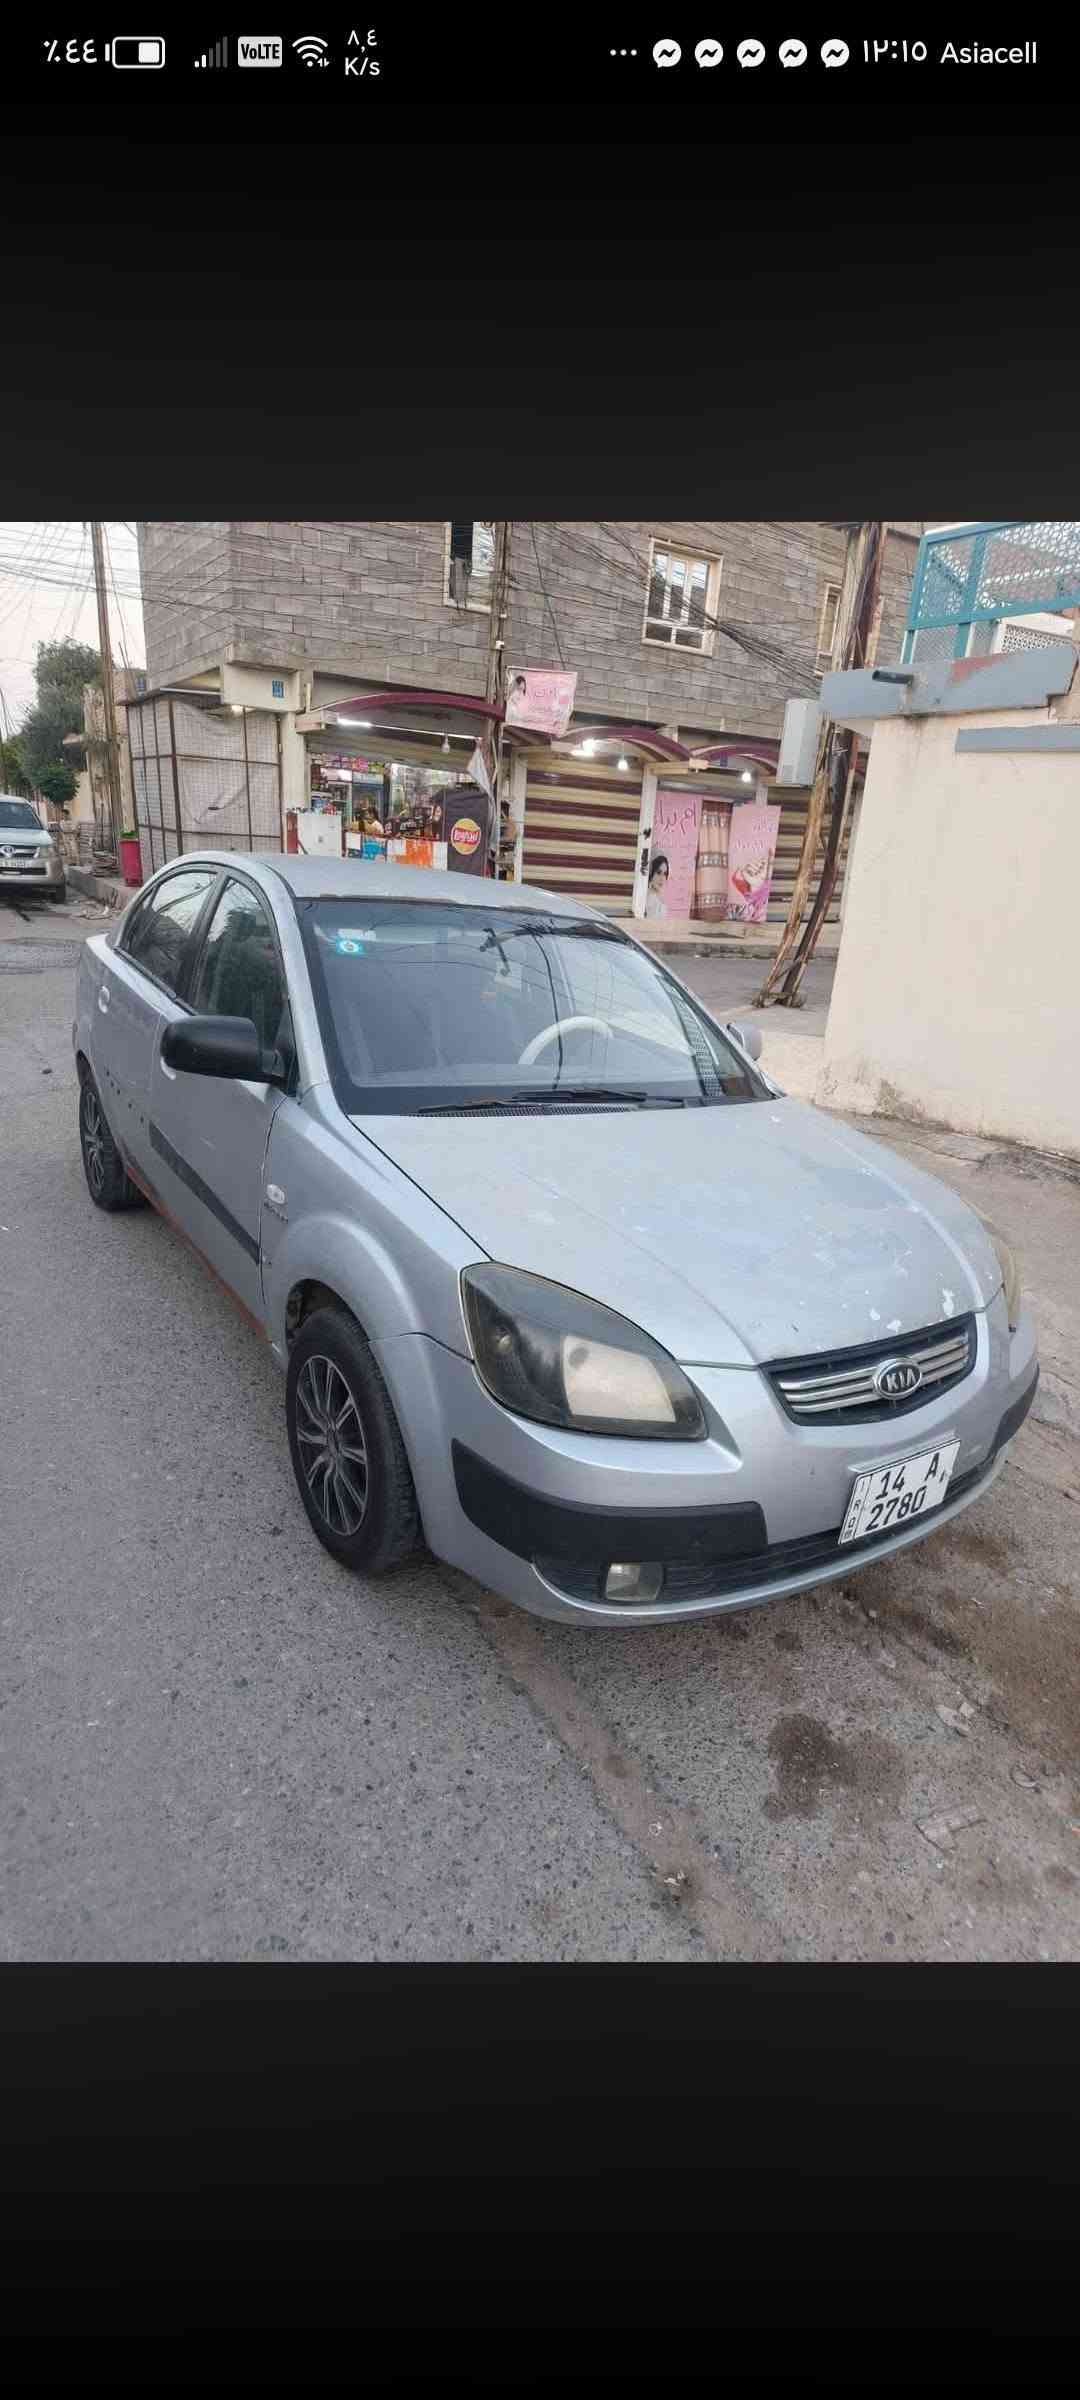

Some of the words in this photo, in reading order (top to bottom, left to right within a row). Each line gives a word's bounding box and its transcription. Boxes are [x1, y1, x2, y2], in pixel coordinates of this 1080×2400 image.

[886, 1367, 917, 1392] KIA
[875, 1465, 906, 1500] 14
[924, 1452, 940, 1481] A
[865, 1485, 927, 1532] 2780
